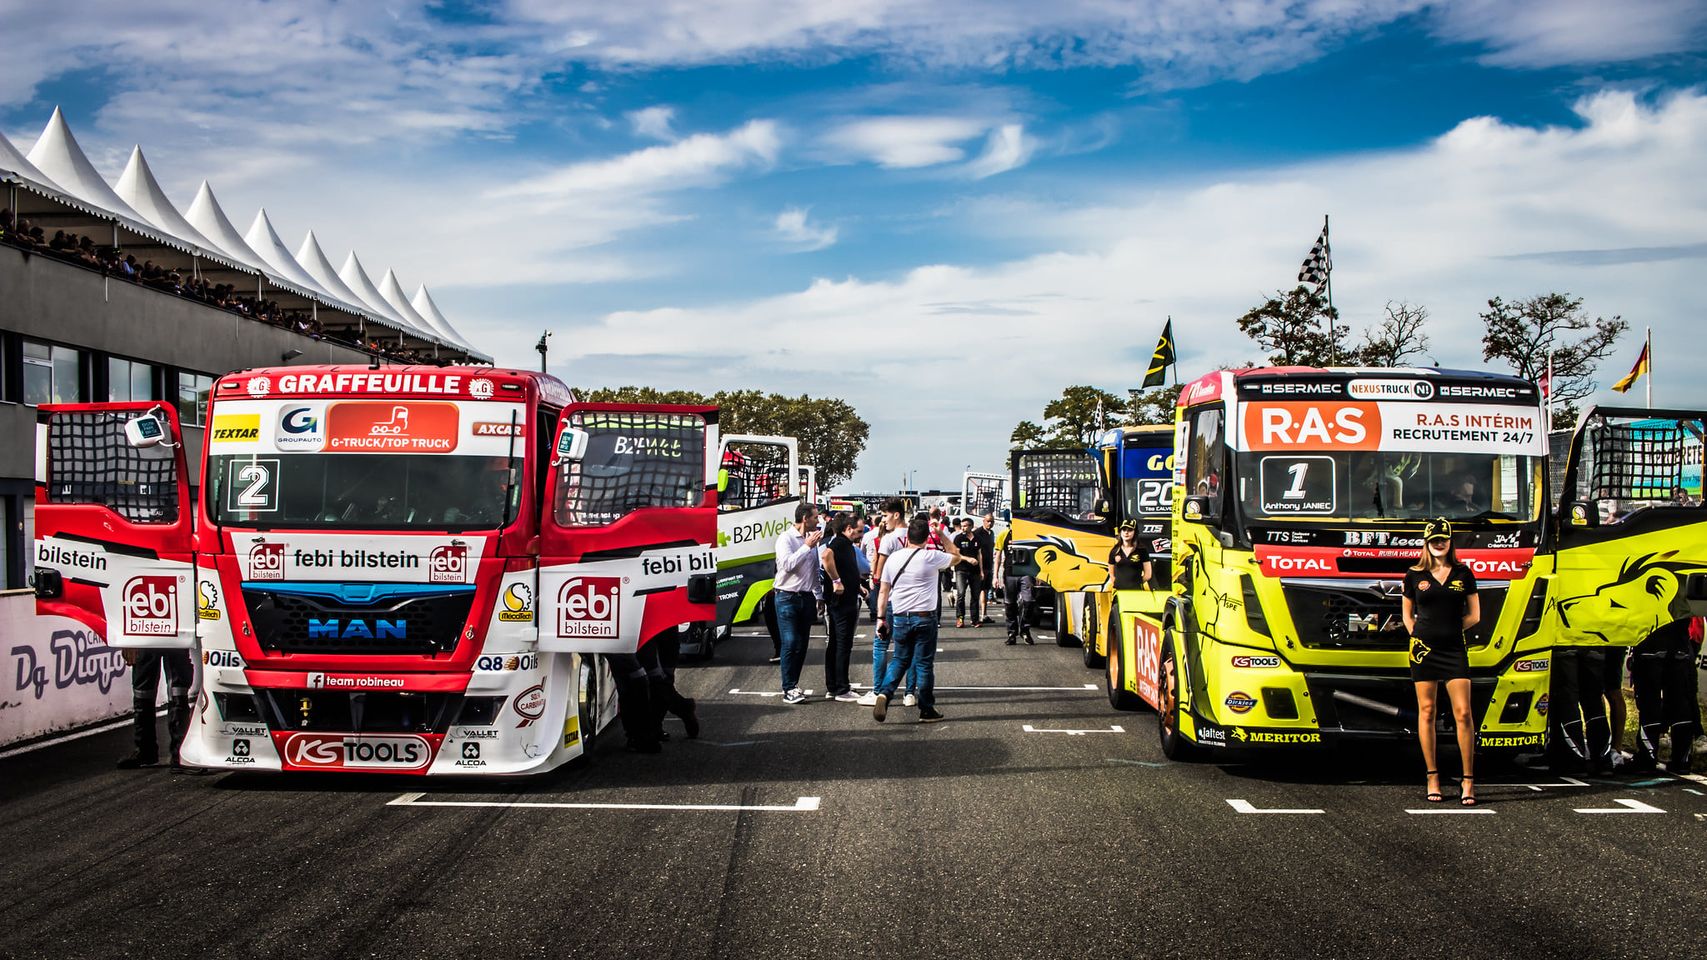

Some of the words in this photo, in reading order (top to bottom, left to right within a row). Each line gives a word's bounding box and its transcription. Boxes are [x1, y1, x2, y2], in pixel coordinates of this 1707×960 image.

[279, 374, 461, 394] GRAFFEUILLE
[1274, 384, 1341, 393] SERMEC
[1451, 386, 1516, 397] SERMEC
[1466, 413, 1532, 429] INTÉRIM
[214, 428, 258, 439] TEXTAR
[478, 424, 522, 435] AXCAR
[1393, 429, 1498, 442] RECRUTEMENT
[1503, 432, 1533, 444] 24/7
[410, 439, 450, 449] TRUCK
[238, 465, 270, 506] 2
[1283, 463, 1309, 499] 1
[1265, 502, 1300, 511] Anthony
[1302, 502, 1331, 510] JANIEC
[1267, 531, 1290, 541] TTS
[1344, 531, 1390, 546] BFT
[38, 545, 107, 570] bilstein
[250, 544, 283, 570] febi
[294, 549, 333, 567] febi
[341, 549, 419, 568] bilstein
[430, 546, 466, 572] febi
[1267, 556, 1331, 570] TOTAL
[642, 555, 682, 576] febi
[1461, 559, 1522, 572] TOTAL
[253, 571, 281, 579] bilstein
[433, 573, 462, 581] bilstein
[123, 578, 176, 619] febi
[557, 578, 619, 620] febi
[130, 620, 171, 633] bilstein
[308, 618, 406, 639] MAN
[565, 622, 611, 635] bilstein
[209, 651, 240, 667] Oils
[1137, 625, 1157, 684] RAS
[1233, 657, 1250, 666] KS
[1250, 658, 1278, 666] TOOLS
[478, 655, 503, 671] Q8
[521, 654, 538, 671] Oils
[327, 677, 354, 686] team
[356, 675, 404, 688] robineau
[1250, 733, 1321, 743] MERITOR
[1480, 735, 1538, 747] MERITOR
[295, 739, 344, 764] KS
[343, 742, 419, 763] TOOLS
